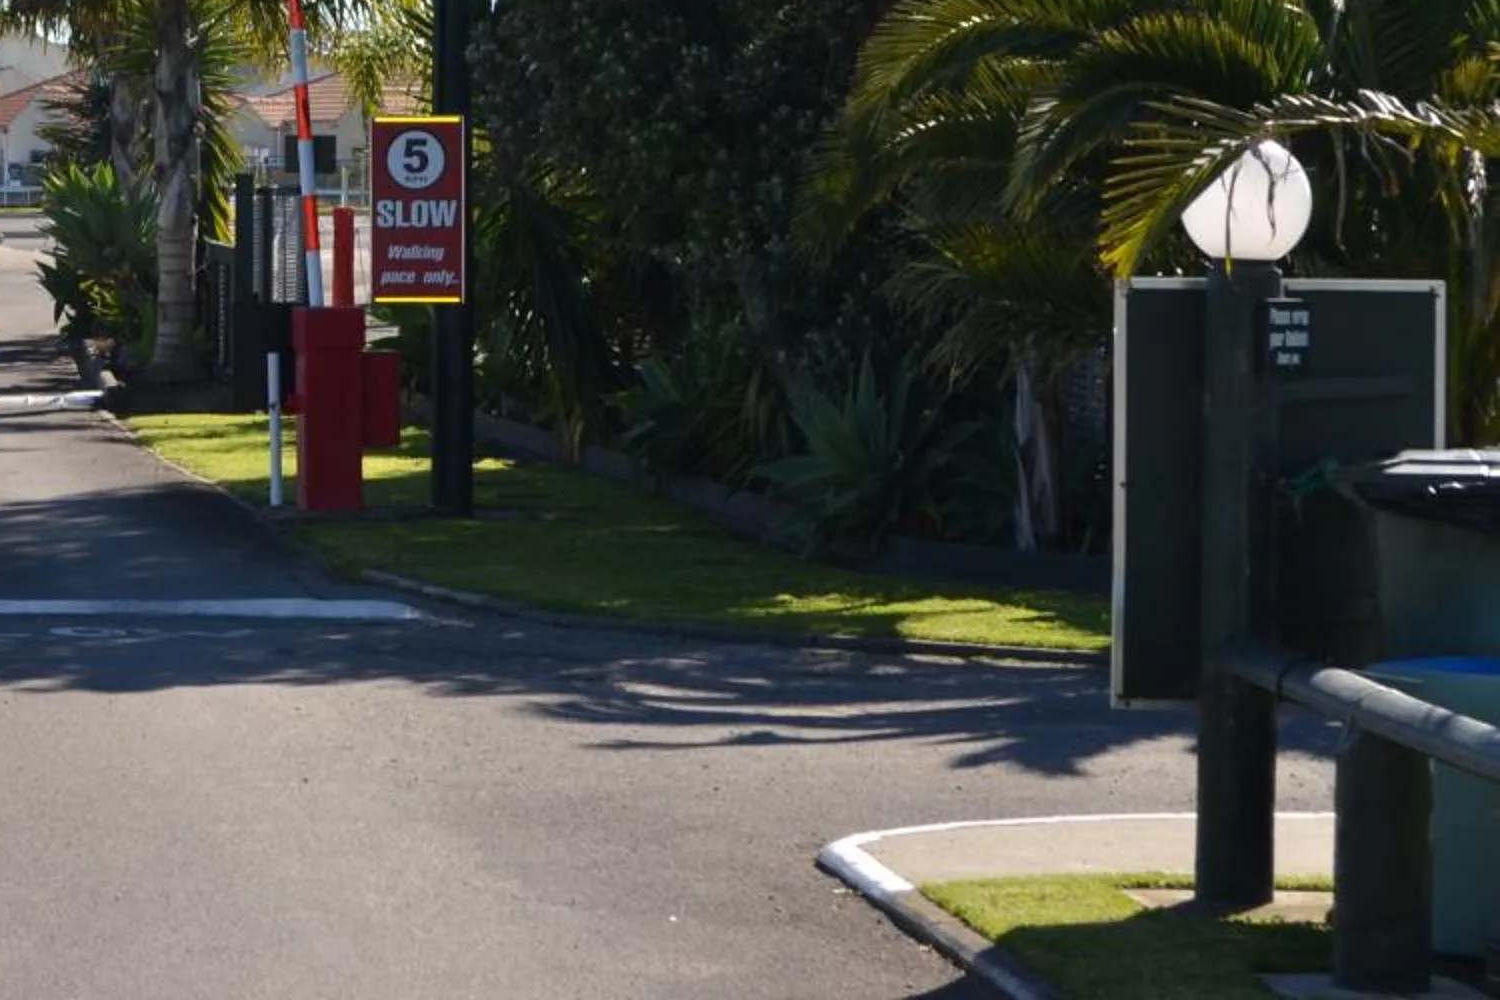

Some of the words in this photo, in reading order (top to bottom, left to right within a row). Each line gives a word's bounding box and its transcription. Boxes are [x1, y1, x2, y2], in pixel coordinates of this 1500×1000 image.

[403, 138, 429, 174] 5
[376, 200, 456, 228] SLOW
[388, 245, 445, 263] Walking
[380, 271, 416, 287] pace
